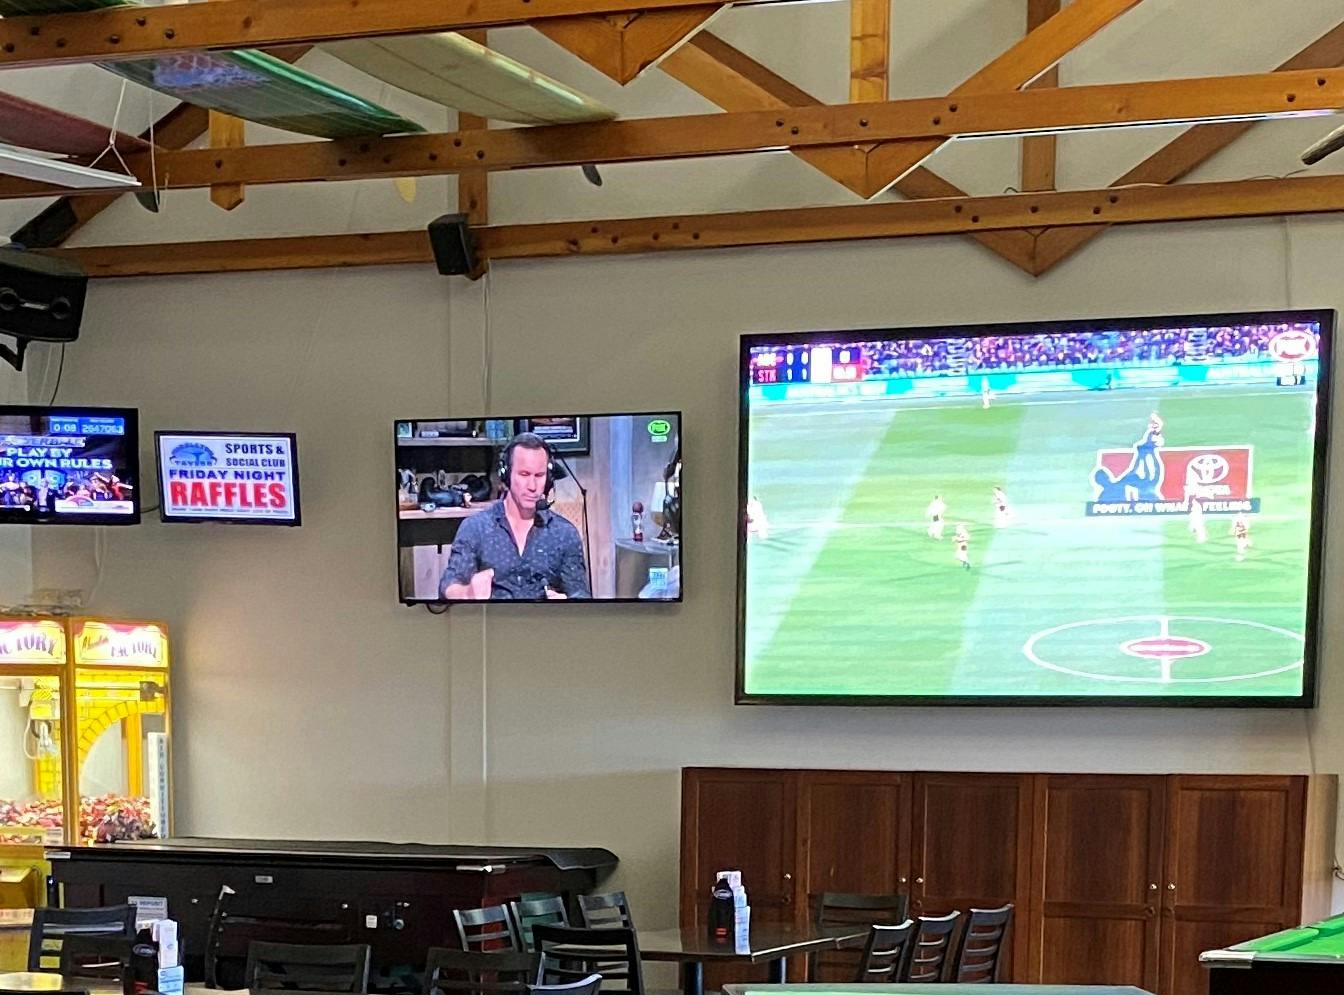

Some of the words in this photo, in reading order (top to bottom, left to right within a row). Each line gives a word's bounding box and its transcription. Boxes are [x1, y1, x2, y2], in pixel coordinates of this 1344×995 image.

[758, 369, 777, 382] STK
[6, 447, 48, 457] PLAY
[50, 448, 72, 457] BY
[225, 443, 273, 455] SPORTS
[276, 446, 285, 454] &
[16, 457, 57, 468] OWN
[60, 459, 112, 469] RULES
[226, 458, 259, 467] SOCIAL
[261, 458, 285, 467] CLUB
[169, 469, 228, 479] FRIDAY
[234, 470, 286, 481] NIGHT
[170, 481, 287, 508] RAFFLES
